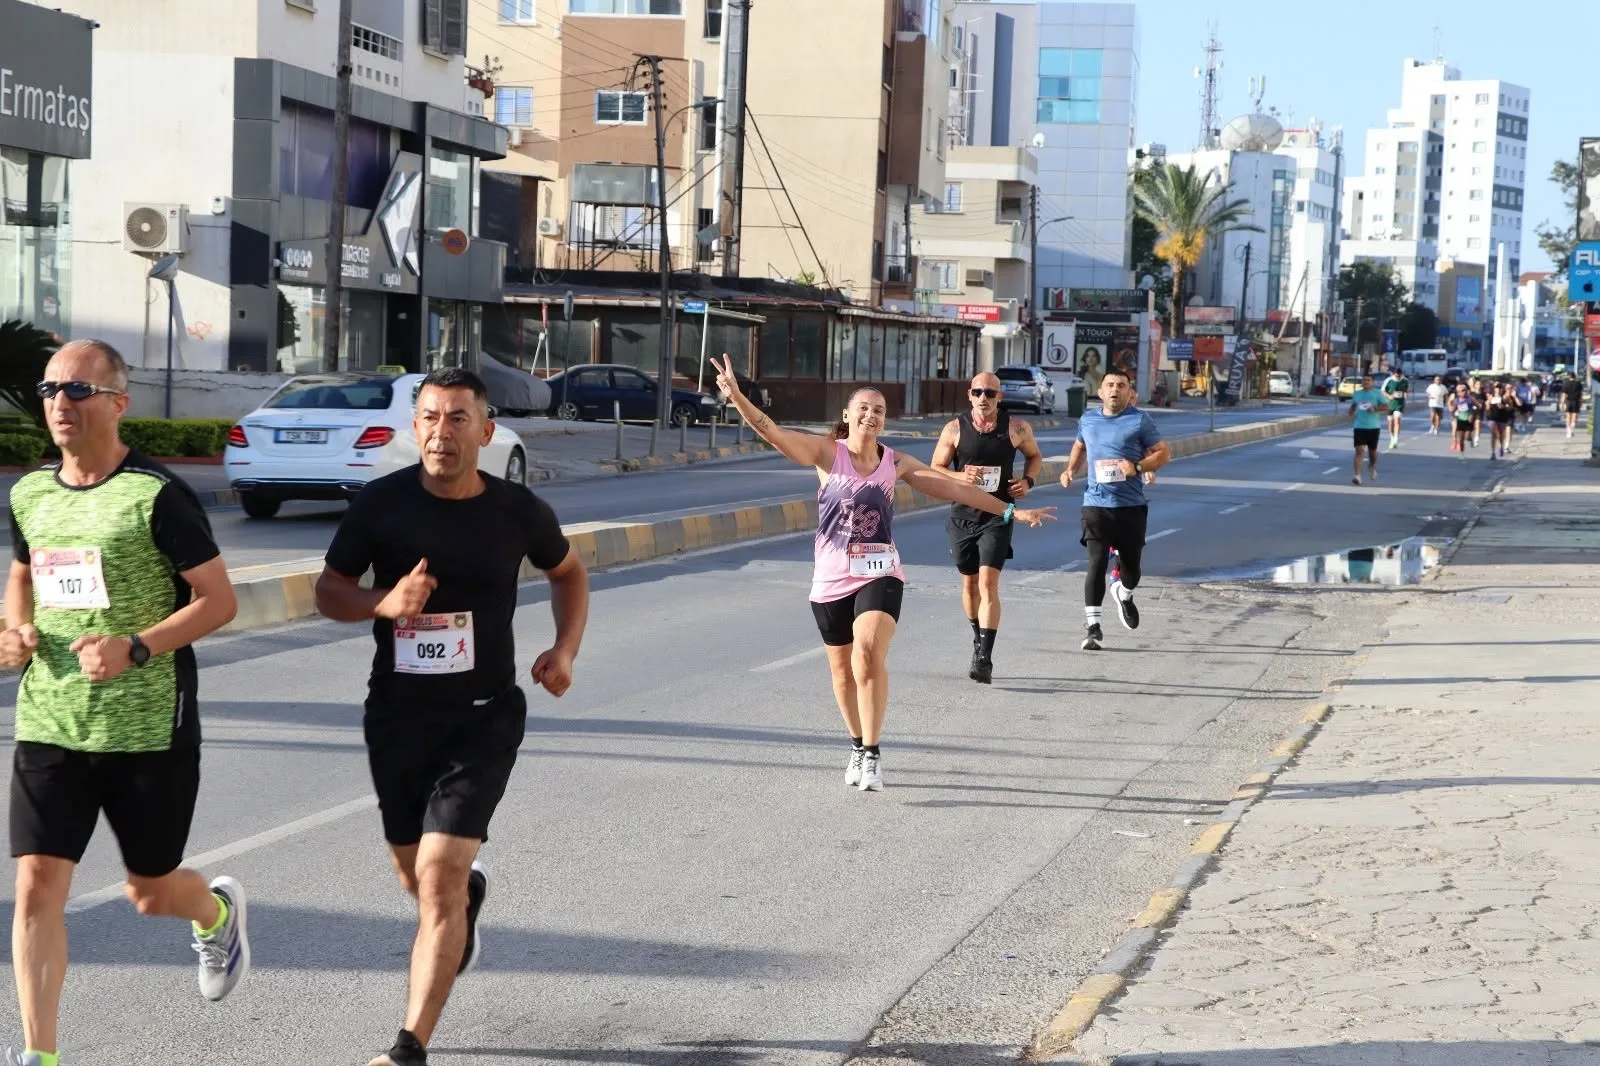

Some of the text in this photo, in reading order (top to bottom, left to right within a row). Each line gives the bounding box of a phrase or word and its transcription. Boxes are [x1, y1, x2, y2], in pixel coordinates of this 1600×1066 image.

[1, 68, 90, 136] Ermataş
[1087, 329, 1112, 337] TOUCH
[867, 560, 883, 570] 111
[59, 578, 82, 594] 107
[417, 643, 446, 659] 092
